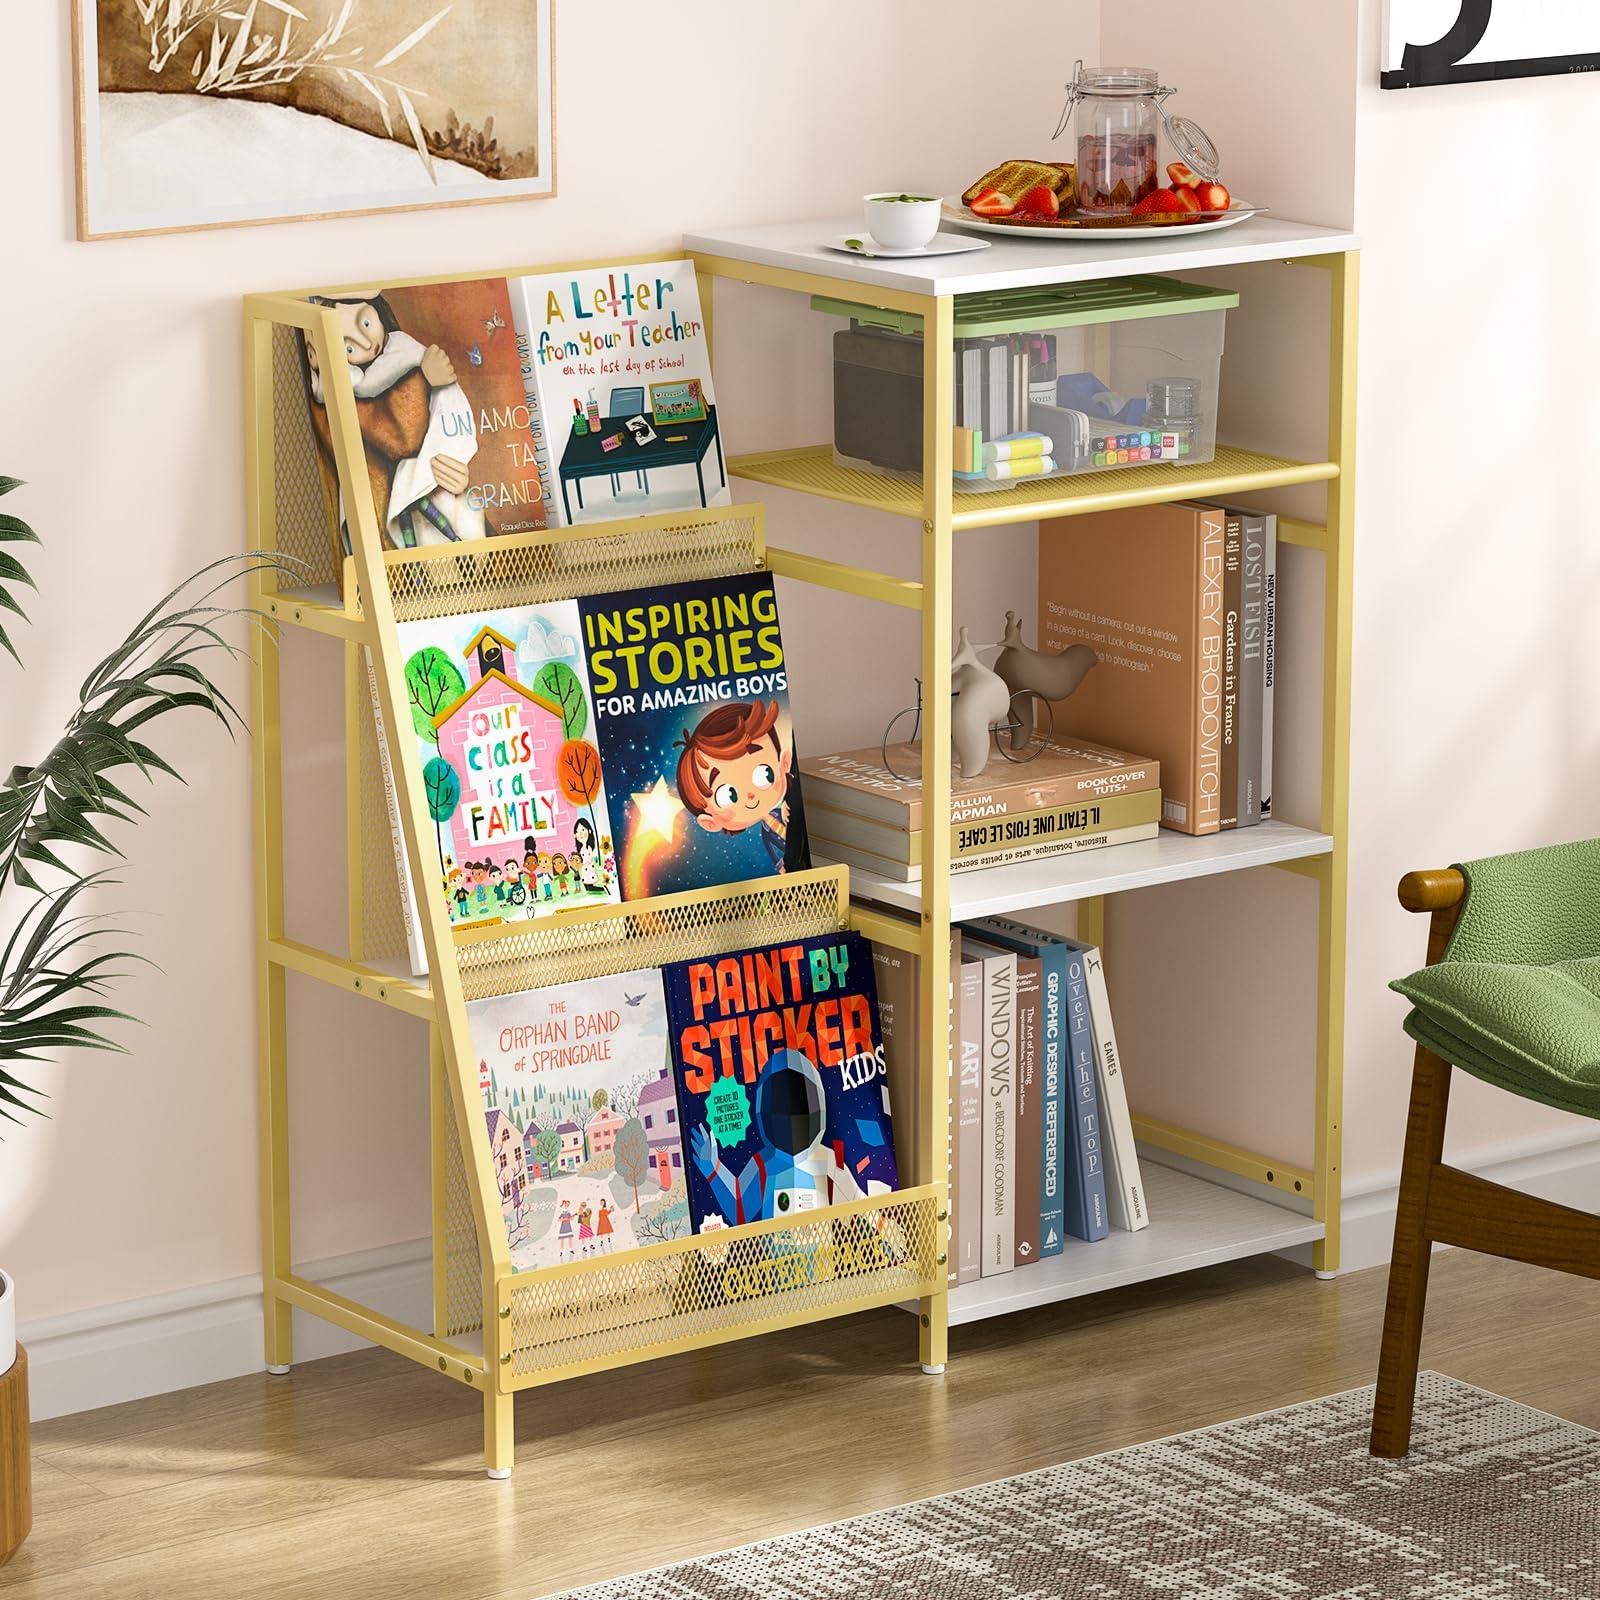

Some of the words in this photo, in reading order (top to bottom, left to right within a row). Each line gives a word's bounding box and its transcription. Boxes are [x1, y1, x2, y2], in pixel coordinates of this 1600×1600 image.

[546, 290, 565, 325] A
[570, 273, 674, 318] Letter
[537, 330, 580, 365] from
[621, 311, 701, 347] Teacher
[562, 365, 575, 375] on
[578, 363, 595, 375] the
[600, 358, 620, 374] last
[625, 358, 641, 375] day
[645, 359, 655, 371] of
[658, 353, 685, 370] School
[441, 411, 473, 437] UN
[506, 442, 538, 467] TA
[465, 478, 543, 511] GRAND
[1202, 520, 1222, 626] ALEXEY
[1245, 526, 1263, 594] LOST
[1266, 574, 1275, 599] NEW
[585, 589, 777, 648] INSPIRING
[1068, 608, 1091, 622] without
[1136, 624, 1147, 635] out
[1153, 629, 1179, 643] window
[1244, 601, 1261, 660] FISH
[1266, 602, 1274, 638] URBAN
[1059, 624, 1077, 637] piece
[1158, 648, 1182, 662] choose
[1225, 611, 1238, 672] Gardens
[590, 626, 784, 694] STORIES
[1265, 639, 1274, 687] HOUSING
[596, 695, 636, 719] FOR
[640, 680, 731, 712] AMAZING
[736, 672, 788, 697] BOYS
[1225, 675, 1236, 691] in
[1200, 635, 1221, 814] BRODOVITCH
[1224, 693, 1236, 745] France
[488, 778, 503, 798] is
[511, 773, 526, 796] a
[1077, 777, 1109, 790] BOOK
[1110, 771, 1145, 784] COVER
[1094, 785, 1128, 795] TUTS+
[470, 793, 556, 841] FAMILY
[1006, 819, 1030, 840] FOIS
[1033, 815, 1055, 833] UNE
[1058, 808, 1088, 831] ÉTAIT
[1092, 806, 1100, 825] IL
[959, 826, 987, 852] CAFÉ
[990, 824, 1003, 843] LE
[1034, 840, 1074, 856] botanique,
[950, 858, 979, 871] secrets
[980, 853, 1003, 865] petits
[1005, 852, 1014, 861] et
[1014, 849, 1032, 859] arts
[687, 945, 805, 1022] PAINT
[808, 944, 850, 993] BY
[549, 1001, 567, 1015] THE
[1027, 1007, 1035, 1024] The
[1047, 972, 1059, 1039] GRAPHIC
[499, 1019, 567, 1053] ORPHAN
[575, 1010, 621, 1039] BAND
[680, 993, 876, 1095] STICKER
[990, 965, 1011, 1097] WINDOWS
[1026, 1041, 1034, 1049] of
[514, 1056, 526, 1072] of
[532, 1040, 612, 1073] SPRINGDALE
[837, 1043, 887, 1092] KIDS
[961, 1041, 980, 1089] ART
[1025, 1051, 1034, 1086] Knitting
[1046, 1042, 1058, 1097] DESIGN
[1103, 1041, 1118, 1077] EAMES
[713, 1093, 732, 1105] CREATE
[732, 1090, 739, 1101] 10
[716, 1102, 739, 1114] PICTURES
[995, 1100, 1002, 1110] at
[713, 1115, 724, 1125] ONE
[724, 1111, 745, 1122] STICKER
[994, 1110, 1005, 1161] BERGDORF
[1045, 1100, 1057, 1197] REFERENCED
[994, 1163, 1005, 1217] GOODMAN
